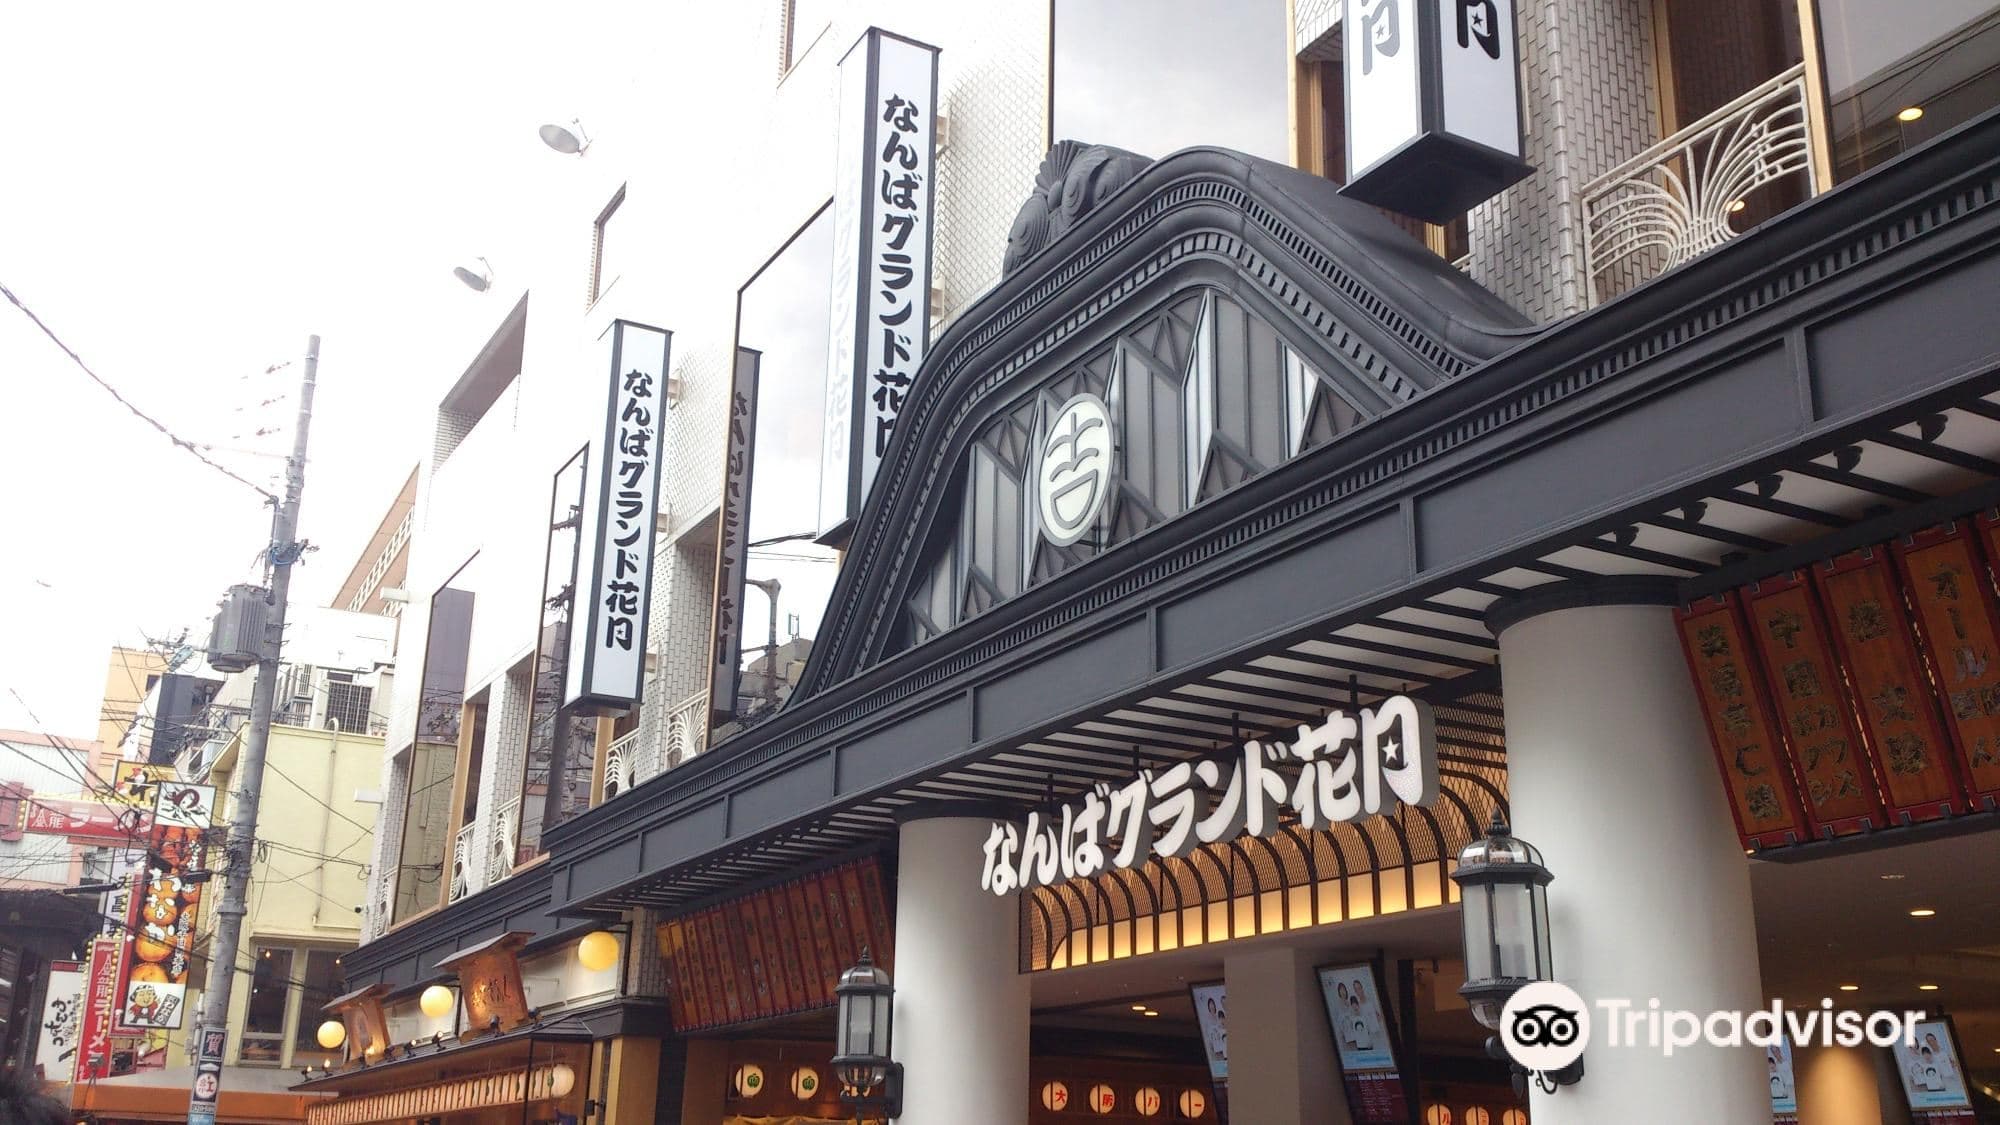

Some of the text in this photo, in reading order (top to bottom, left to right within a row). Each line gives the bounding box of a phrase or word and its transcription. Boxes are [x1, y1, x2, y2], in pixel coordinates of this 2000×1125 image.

[605, 368, 654, 652] なんばグランド花月
[981, 695, 1424, 896] なんばグランド花月
